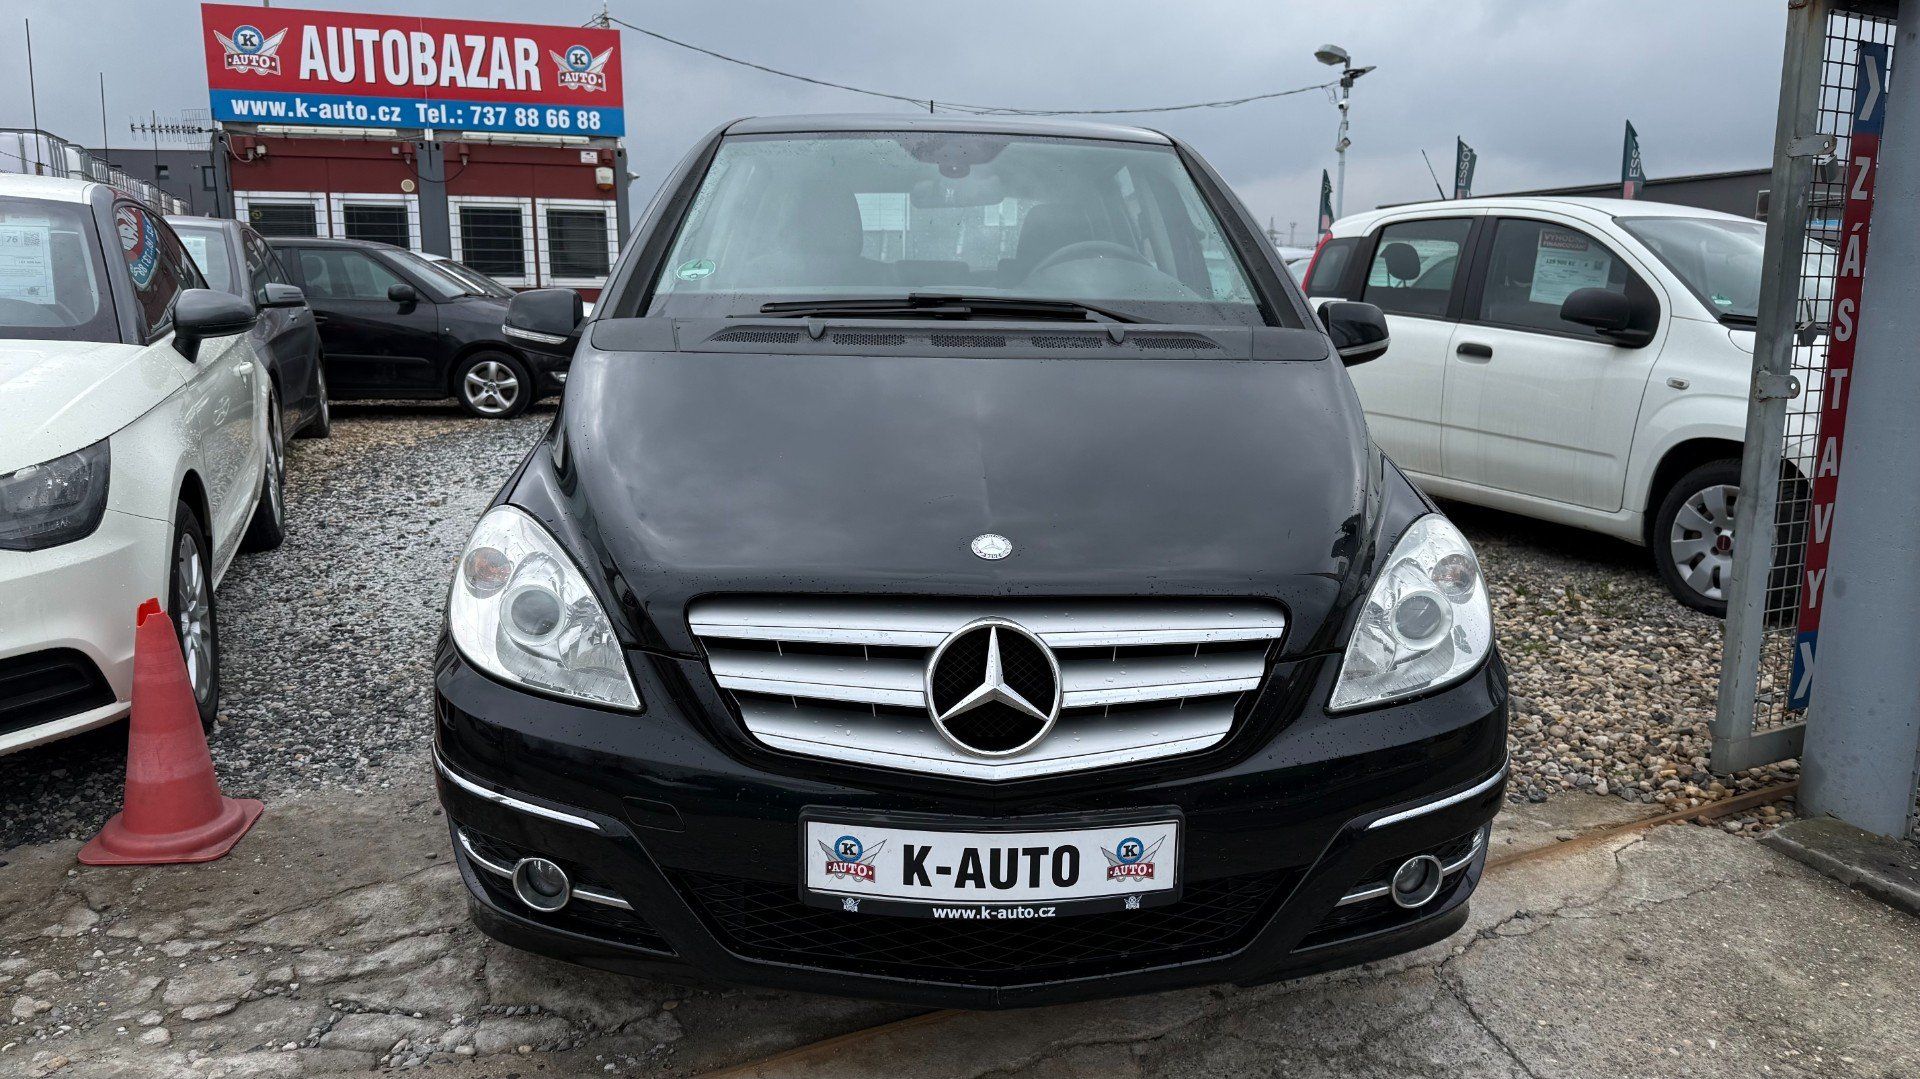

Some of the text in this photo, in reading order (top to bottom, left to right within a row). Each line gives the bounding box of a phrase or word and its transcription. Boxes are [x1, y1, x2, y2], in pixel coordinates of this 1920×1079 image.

[241, 34, 257, 46] K
[232, 55, 270, 68] AUTO
[299, 25, 542, 91] AUTOBAZAR
[573, 54, 586, 65] K
[565, 72, 597, 85] AUTO
[231, 98, 601, 130] www.k-auto.cz Tel.: 737 88 66 88
[1806, 156, 1871, 609] ZÁSTAVY
[842, 843, 856, 856] K
[1123, 844, 1137, 857] K
[831, 862, 868, 877] AUTO
[902, 844, 1080, 889] K-AUTO
[1113, 863, 1147, 876] AUTO
[932, 906, 1056, 920] www.k-auto.cz
